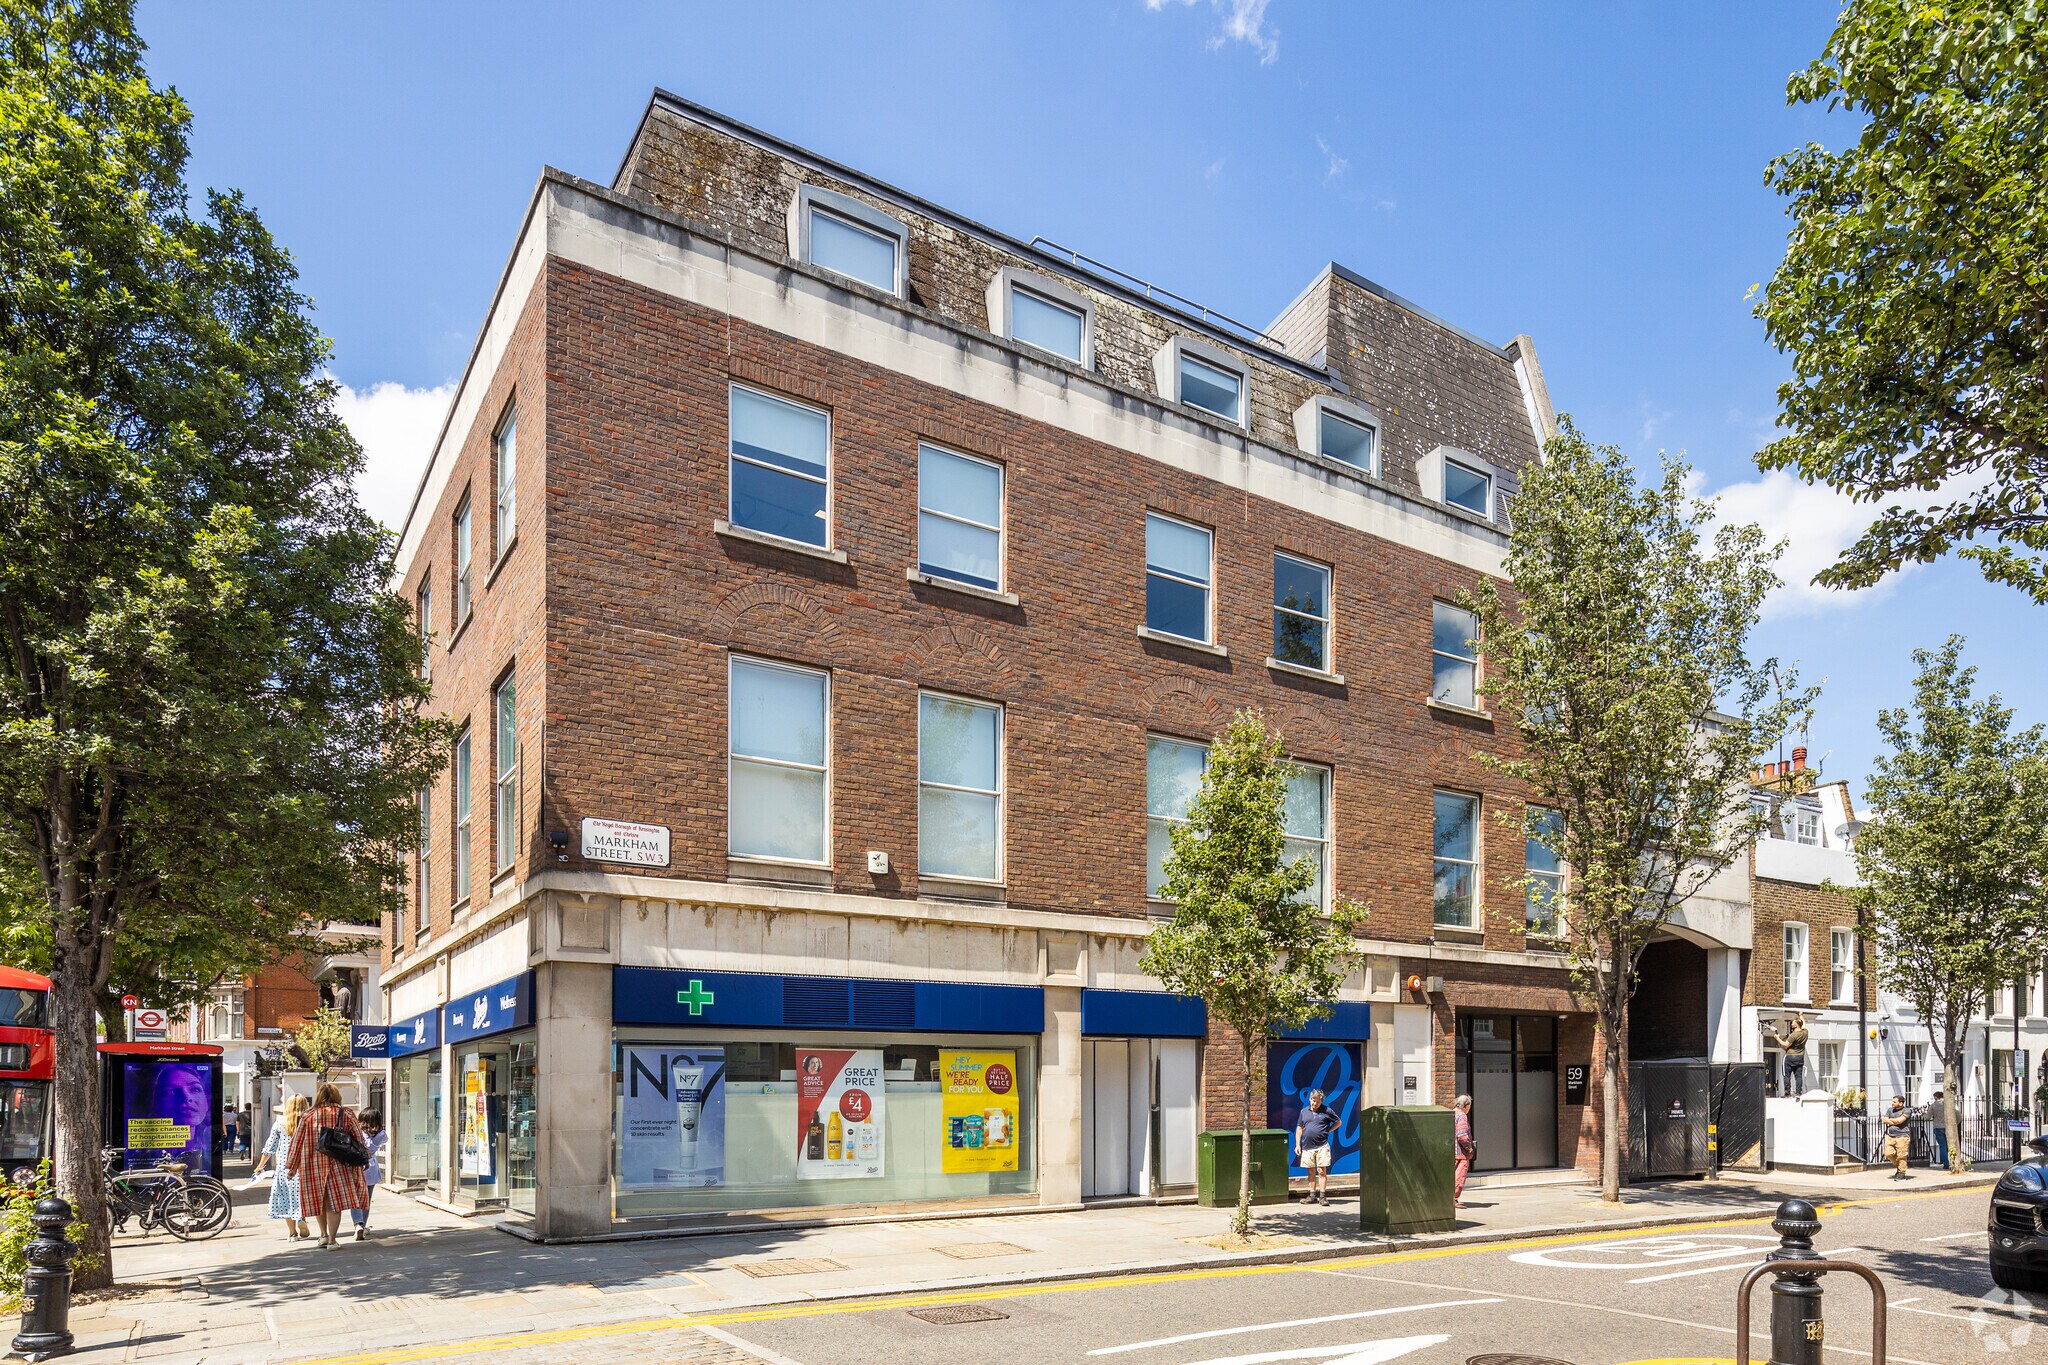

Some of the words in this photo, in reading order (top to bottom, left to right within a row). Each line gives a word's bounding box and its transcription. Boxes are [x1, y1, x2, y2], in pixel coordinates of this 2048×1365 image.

[639, 826, 660, 834] Kensington
[594, 836, 658, 851] MARKHAM
[355, 1033, 386, 1048] Boots
[845, 1068, 878, 1077] GREAT
[1568, 1068, 1583, 1080] 59
[845, 1078, 875, 1086] PRICE
[848, 1097, 862, 1112] £4
